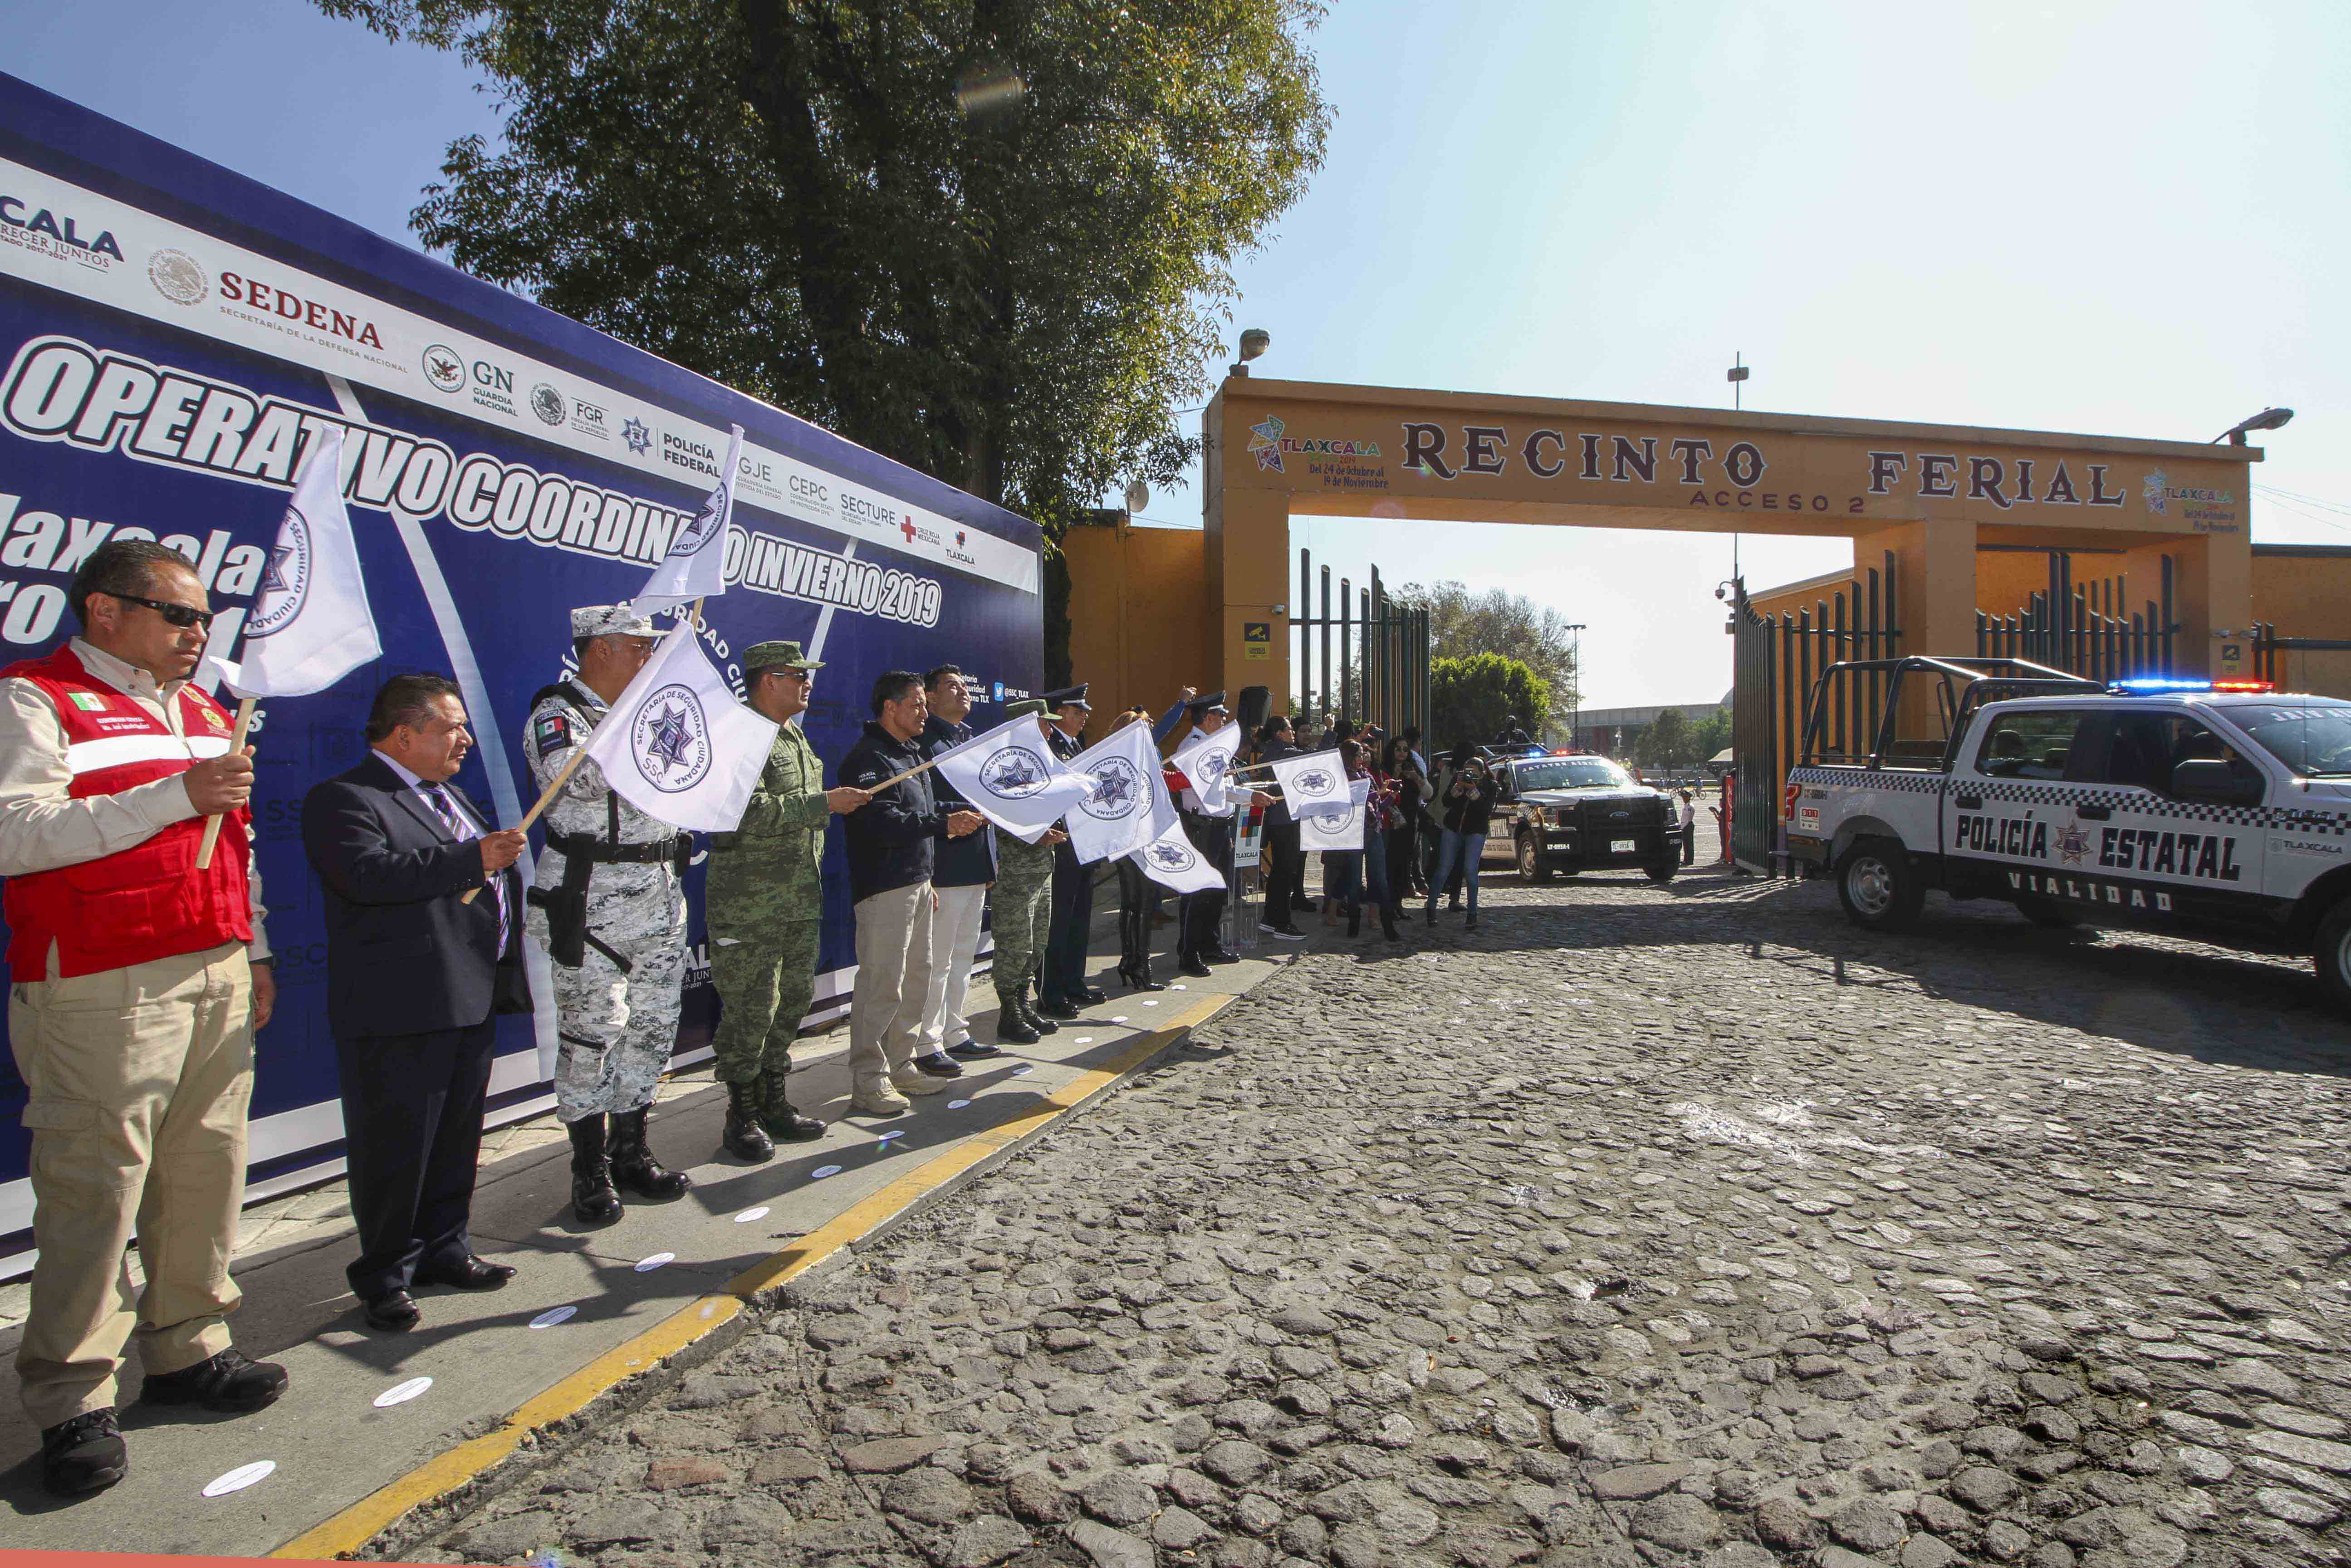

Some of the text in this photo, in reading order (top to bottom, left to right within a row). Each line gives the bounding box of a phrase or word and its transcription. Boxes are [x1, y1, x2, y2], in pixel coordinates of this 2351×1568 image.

[25, 243, 68, 262] 2017-2021
[54, 240, 109, 268] JUNTOS
[220, 271, 384, 351] SEDENA
[220, 306, 284, 333] SECRETARÍA
[287, 328, 300, 338] DE
[304, 333, 315, 343] LA
[318, 338, 361, 357] DEFENSA
[363, 353, 409, 374] NACIONAL
[473, 361, 515, 393] GN
[473, 387, 513, 406] GUARDIA
[473, 397, 519, 417] NACIONAL
[577, 402, 604, 425] FGR
[663, 432, 715, 461] POLICÍA
[1280, 437, 1381, 457] TLAXCALA
[664, 449, 721, 478] FEDERAL
[739, 456, 771, 482] GJE
[1309, 464, 1322, 474] Del
[1323, 464, 1334, 474] 24
[1336, 465, 1345, 474] de
[1347, 466, 1375, 477] Octubre
[1401, 422, 2126, 511] RECINTO FERIAL
[2, 340, 452, 515] OPERATIVO
[745, 533, 883, 612] INVIERNO
[879, 570, 940, 627] 2019
[789, 475, 828, 502] CEPC
[1332, 475, 1342, 487] de
[1343, 476, 1389, 488] Noviembre
[765, 490, 781, 501] ESTADO
[1690, 490, 1864, 513] ACCESO 2
[2164, 487, 2236, 504] TLAXCALA
[701, 493, 723, 543] SEGURIDAD
[841, 494, 896, 526] SECTURE
[917, 526, 940, 540] CRUZ ROJA
[917, 533, 941, 546] MEXICANA
[290, 522, 306, 594] SEGURIDAD
[946, 548, 976, 565] TLAXCALA
[980, 695, 990, 704] TLX
[1004, 687, 1029, 700] @SSC_TLAX
[637, 694, 666, 745] SECRETARÍA
[676, 691, 702, 738] SEGURIDAD
[642, 757, 664, 784] SSC
[674, 740, 706, 785] CIUDADANA
[984, 750, 1017, 777] SECRETARÍA
[1089, 759, 1118, 775] CRETARÍA
[1127, 767, 1137, 803] SEGURIDAD
[1096, 802, 1131, 816] CIUDADANA
[1954, 808, 2241, 882] POLICÍA ESTATAL
[2282, 840, 2343, 854] TLAXCALA
[2008, 872, 2173, 911] VIALIDAD
